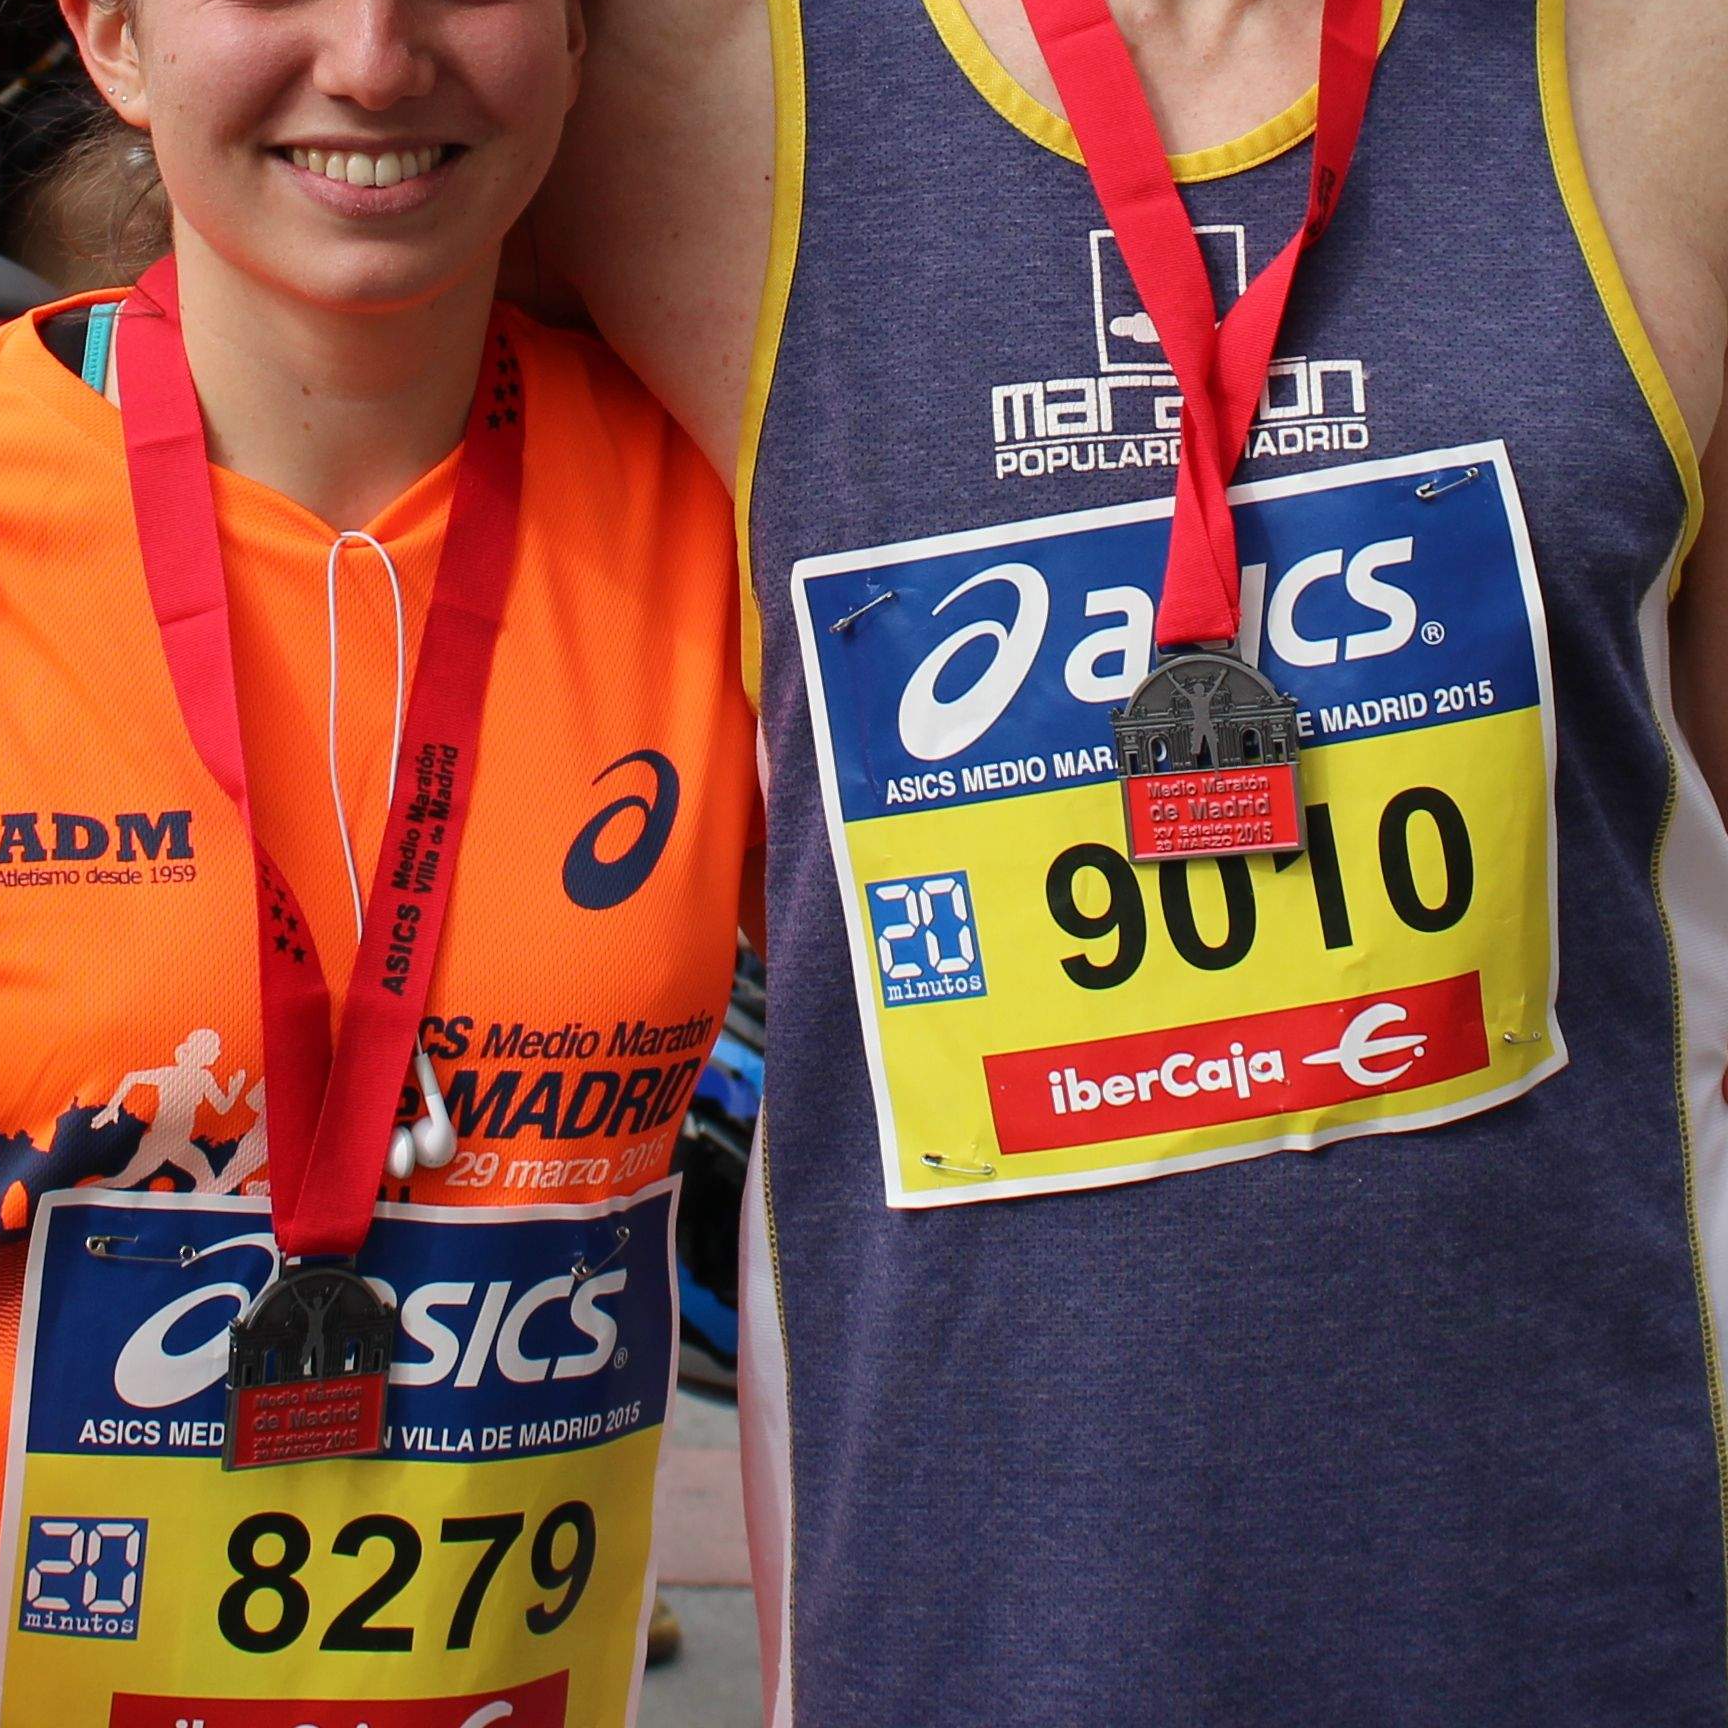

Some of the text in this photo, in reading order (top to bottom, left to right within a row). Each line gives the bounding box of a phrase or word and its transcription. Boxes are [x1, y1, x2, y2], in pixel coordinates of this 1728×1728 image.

[1245, 423, 1369, 459] ADRID
[886, 771, 957, 806] ASICS
[961, 755, 1047, 794] MEDIO
[1319, 692, 1428, 734] MADRID
[1434, 679, 1494, 714] 2015
[1146, 774, 1269, 799] Medio Maratón
[1149, 793, 1270, 822] de Madrid
[390, 743, 436, 890] Medio Maratón
[1235, 821, 1272, 845] 2015
[1177, 835, 1233, 850] MARZO
[85, 866, 143, 886] desde
[149, 865, 197, 885] 1959
[381, 744, 459, 996] ASICS Villa de Madrid
[1045, 785, 1474, 990] 9010
[875, 877, 975, 980] 20
[887, 974, 982, 1001] minutos
[480, 1023, 600, 1060] Medio
[606, 1009, 714, 1058] Maratón
[446, 1057, 701, 1140] MADRID
[1048, 1042, 1286, 1115] iberCaja
[444, 1132, 669, 1190] 29 marzo 2015
[78, 1419, 161, 1445] ASICS
[168, 1421, 225, 1446] MED
[402, 1426, 474, 1452] VILLA
[481, 1426, 513, 1451] DE
[518, 1413, 602, 1448] MADRID
[605, 1400, 641, 1434] 2015
[254, 1402, 361, 1431] de Madrid
[324, 1428, 358, 1450] 2015
[27, 1522, 140, 1614] 20
[217, 1499, 597, 1654] 8279
[24, 1611, 135, 1634] minutos
